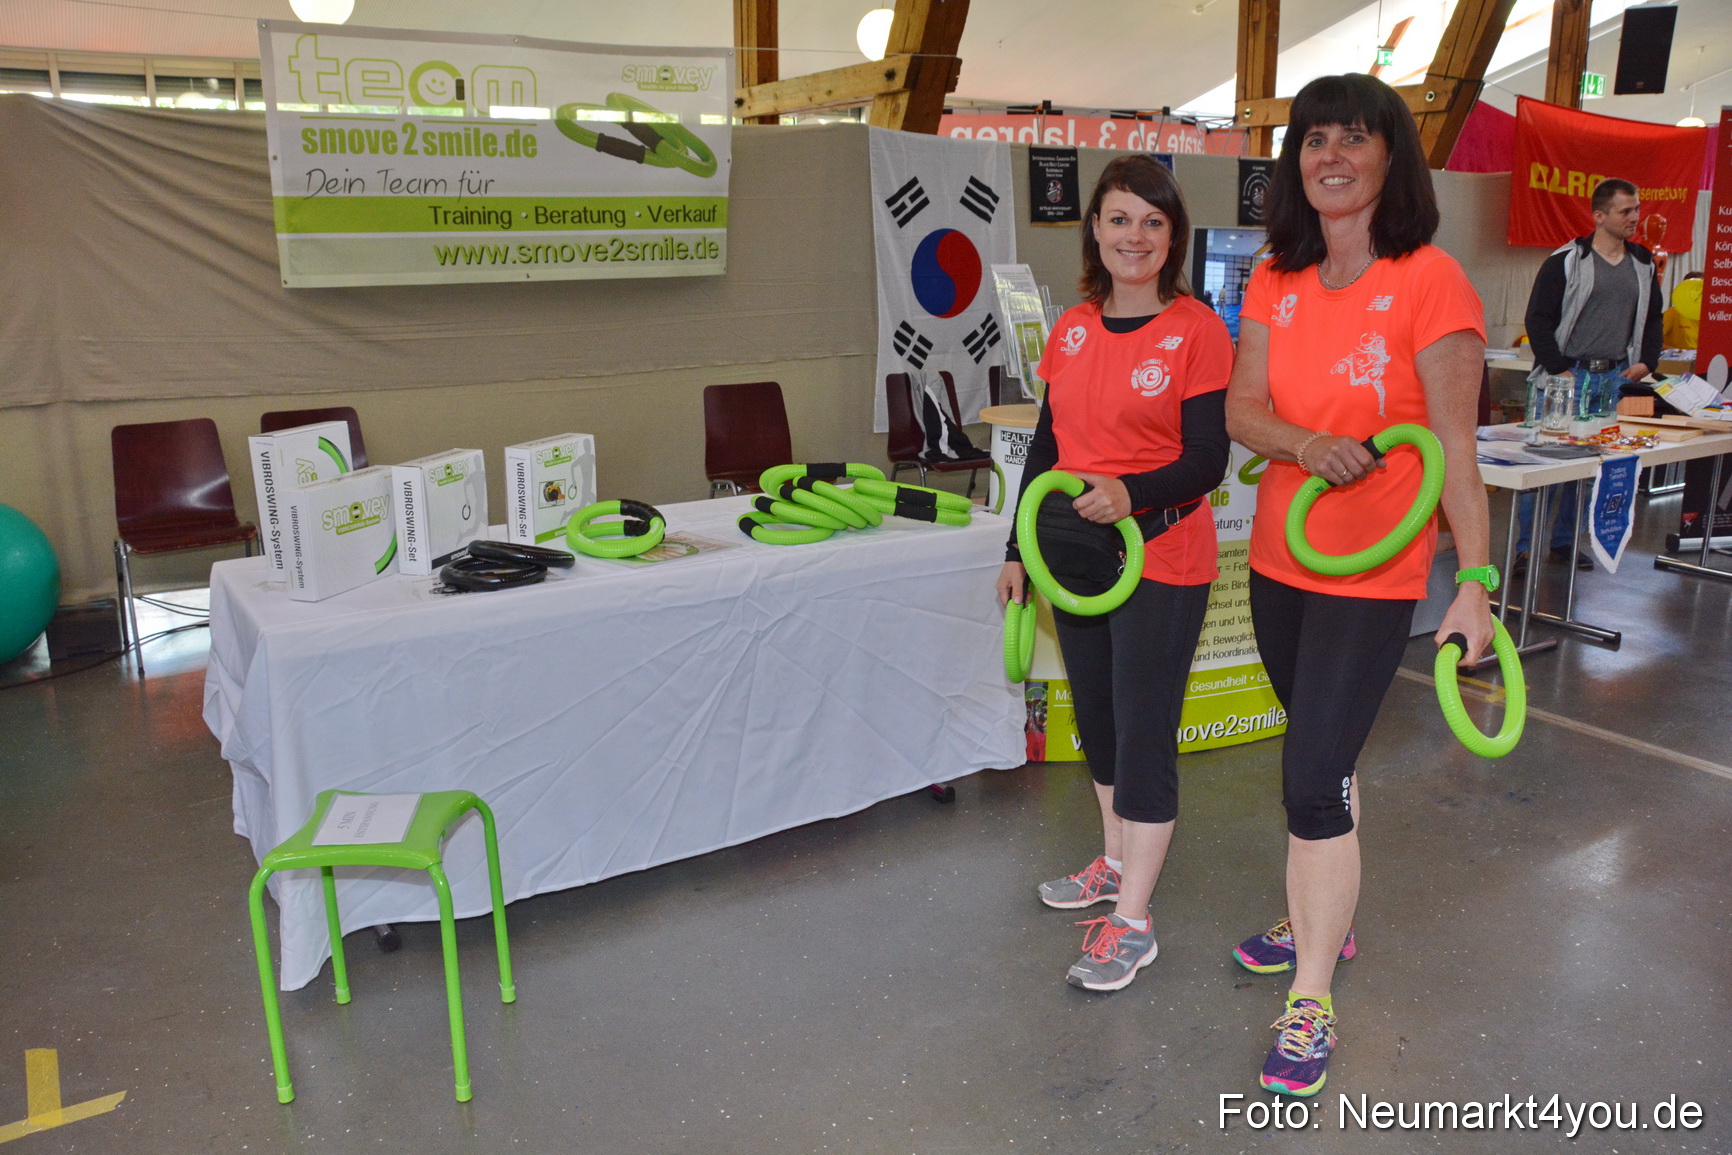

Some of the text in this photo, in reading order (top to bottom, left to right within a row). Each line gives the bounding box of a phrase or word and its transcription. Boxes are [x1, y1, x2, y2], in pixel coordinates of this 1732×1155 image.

[288, 33, 537, 115] team
[622, 64, 713, 91] smovey
[303, 168, 495, 203] Dein Team für
[428, 204, 718, 229] Training Beratung Verkauf
[433, 235, 719, 266] www.smove2smile.de
[535, 442, 579, 464] smovey
[428, 460, 469, 483] smovey
[260, 451, 284, 570] VIBROSWING-System
[322, 493, 390, 530] smovey
[516, 462, 527, 538] VIBROSWING-Set
[403, 481, 417, 562] VIBROSWING-Set
[290, 505, 305, 589] VIBROSWING-System
[1213, 582, 1229, 593] das
[1219, 616, 1235, 627] und
[1190, 674, 1247, 693] Gesundheit
